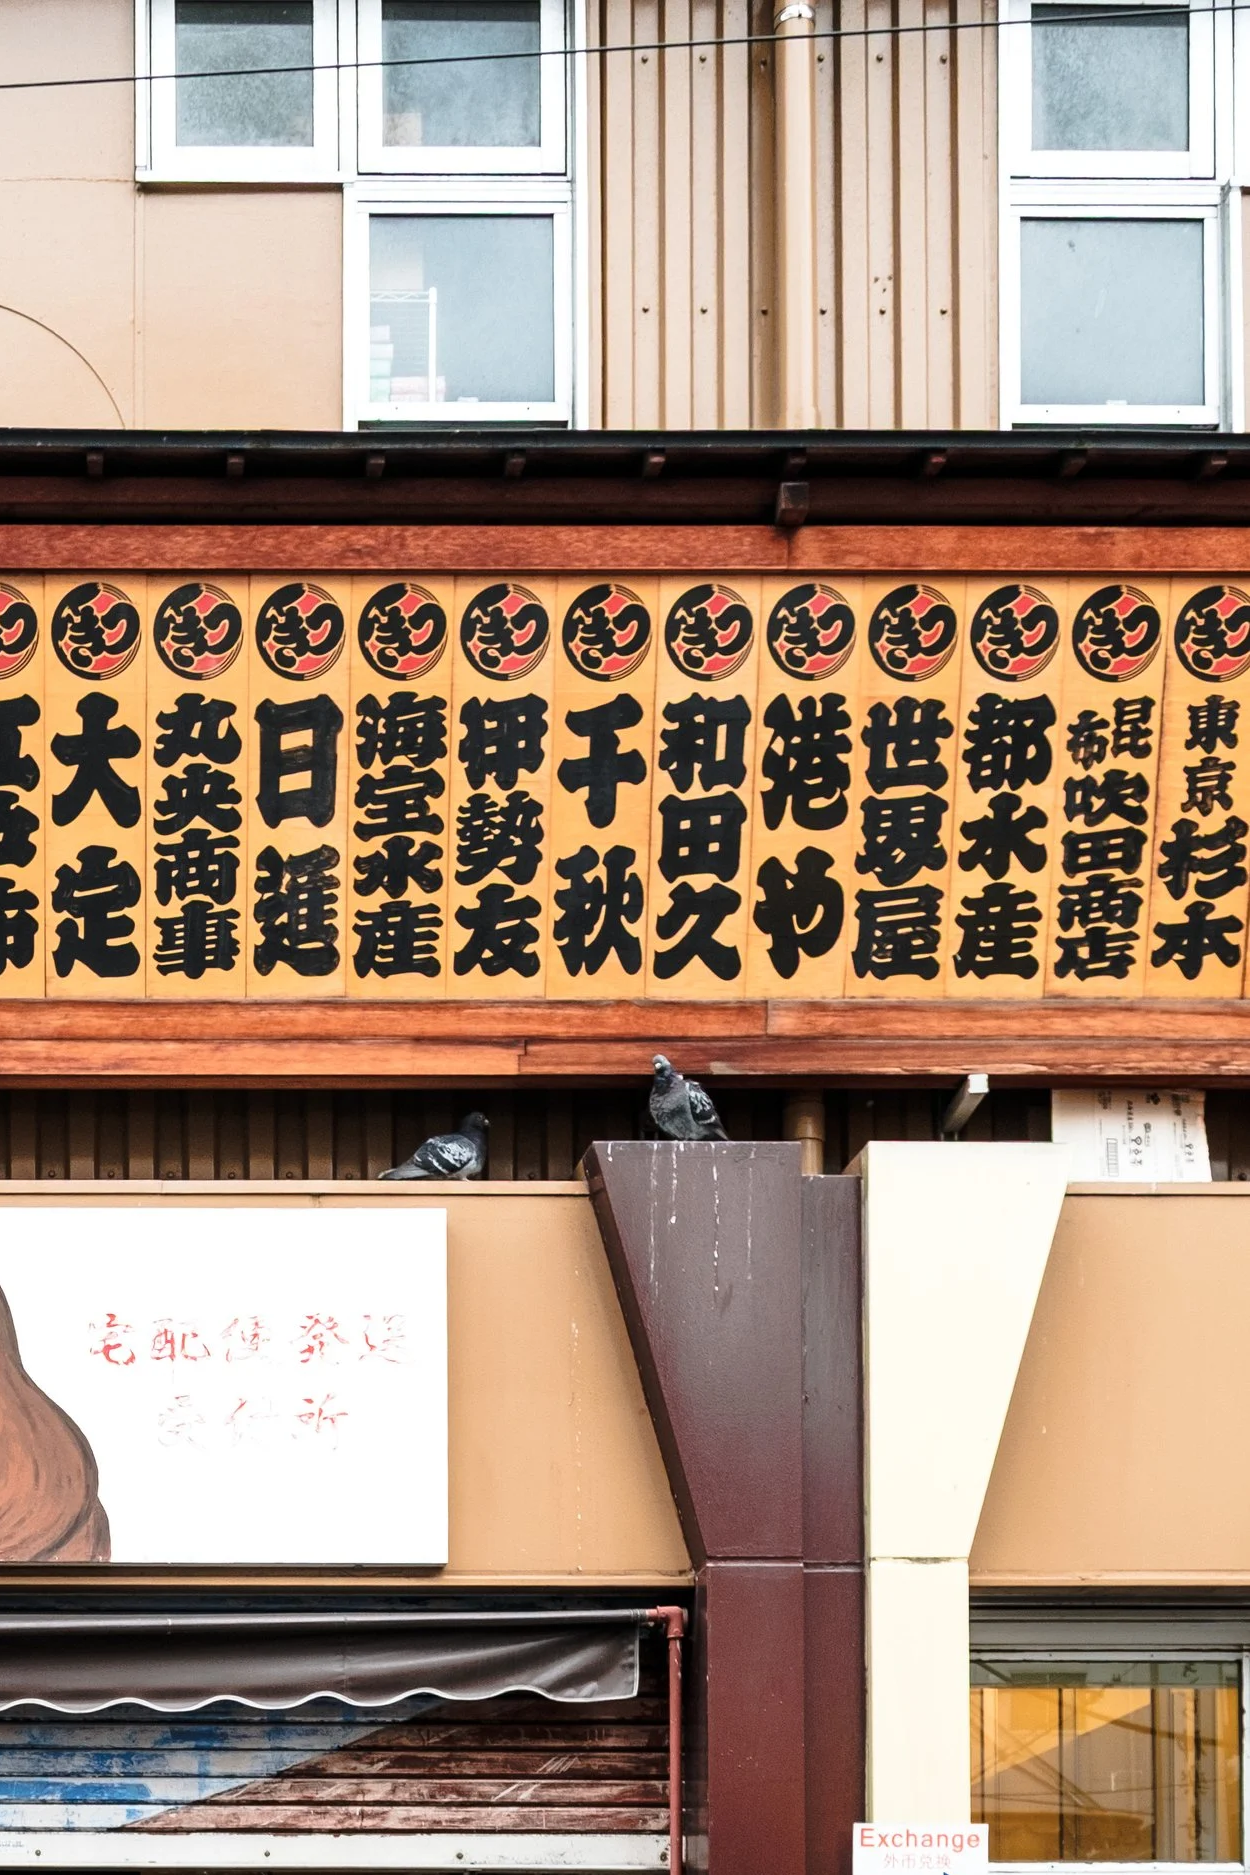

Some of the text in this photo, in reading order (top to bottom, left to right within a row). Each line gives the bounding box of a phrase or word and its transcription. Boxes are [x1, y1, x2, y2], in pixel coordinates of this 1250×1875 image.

[51, 692, 143, 978] 大定
[254, 694, 344, 977] 日進
[352, 691, 447, 979] 海宝水産
[454, 693, 549, 978] 伊勢友
[553, 693, 647, 977] 千秋
[653, 692, 752, 981] 和田久
[753, 692, 852, 980] 港や
[953, 693, 1056, 980] 都水産
[1151, 695, 1249, 980] 東京杉本
[860, 1828, 980, 1853] Exchange
